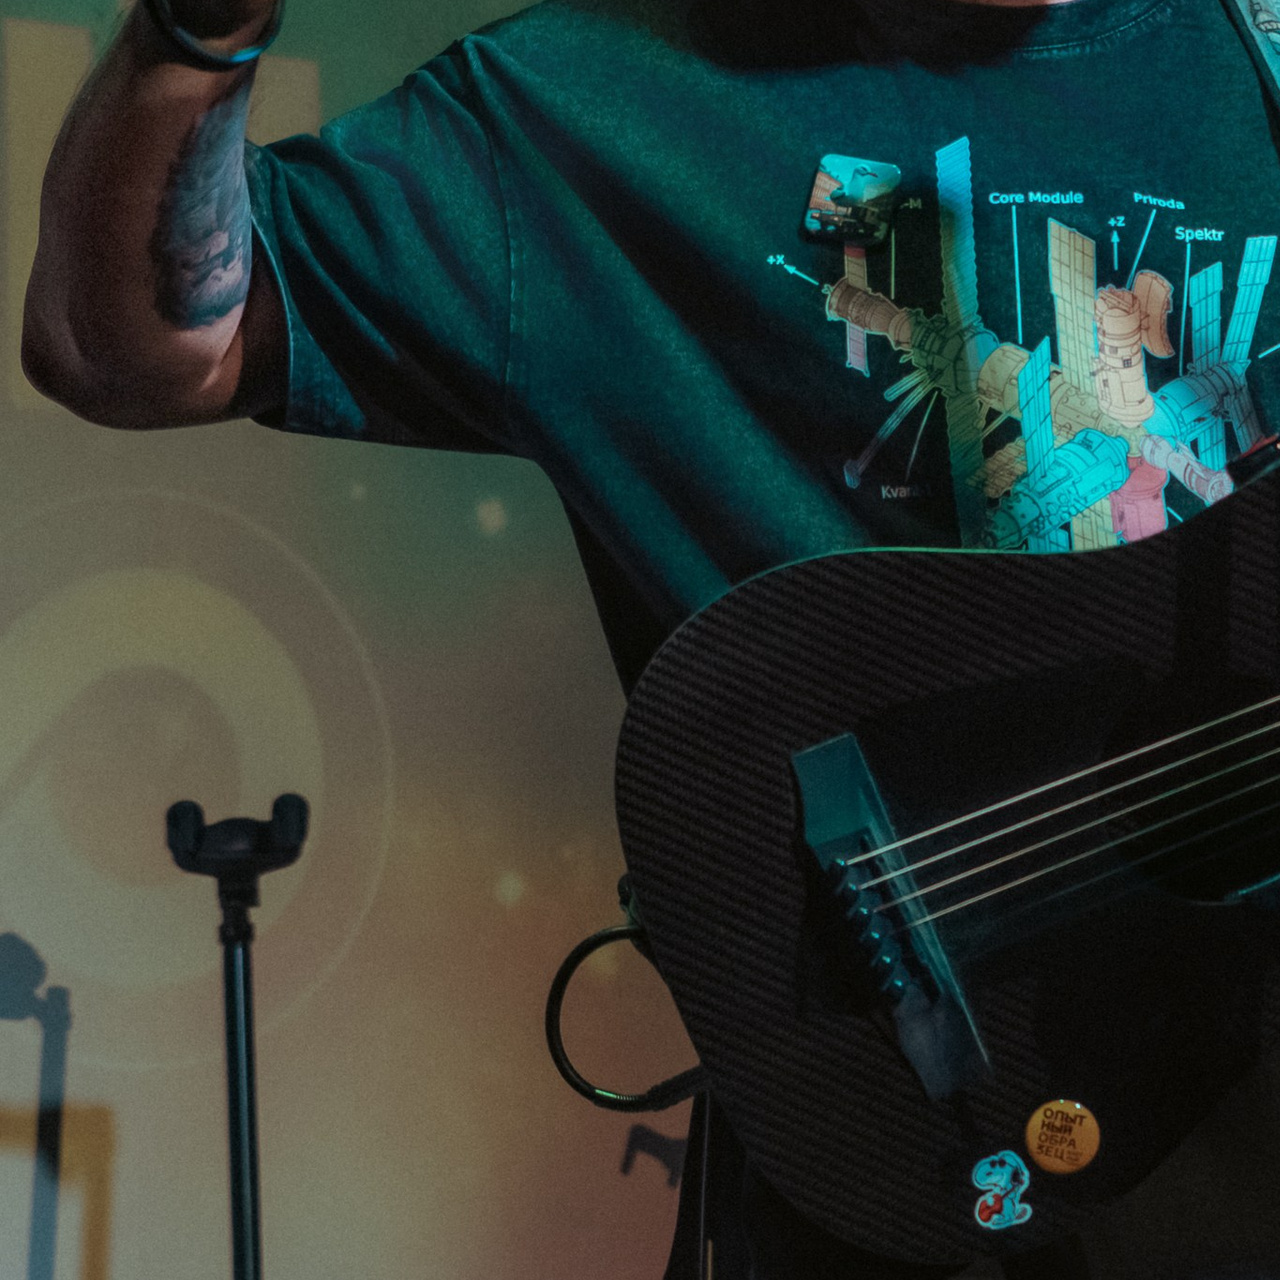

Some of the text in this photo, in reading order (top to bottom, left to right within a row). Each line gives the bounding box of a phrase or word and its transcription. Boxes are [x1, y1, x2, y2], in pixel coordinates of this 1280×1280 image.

[988, 190, 1084, 205] Core Module
[1133, 192, 1185, 210] Priroda
[1174, 226, 1225, 243] Spektr
[1043, 1107, 1087, 1126] ОПЫТ
[1038, 1131, 1077, 1150] ОБРА
